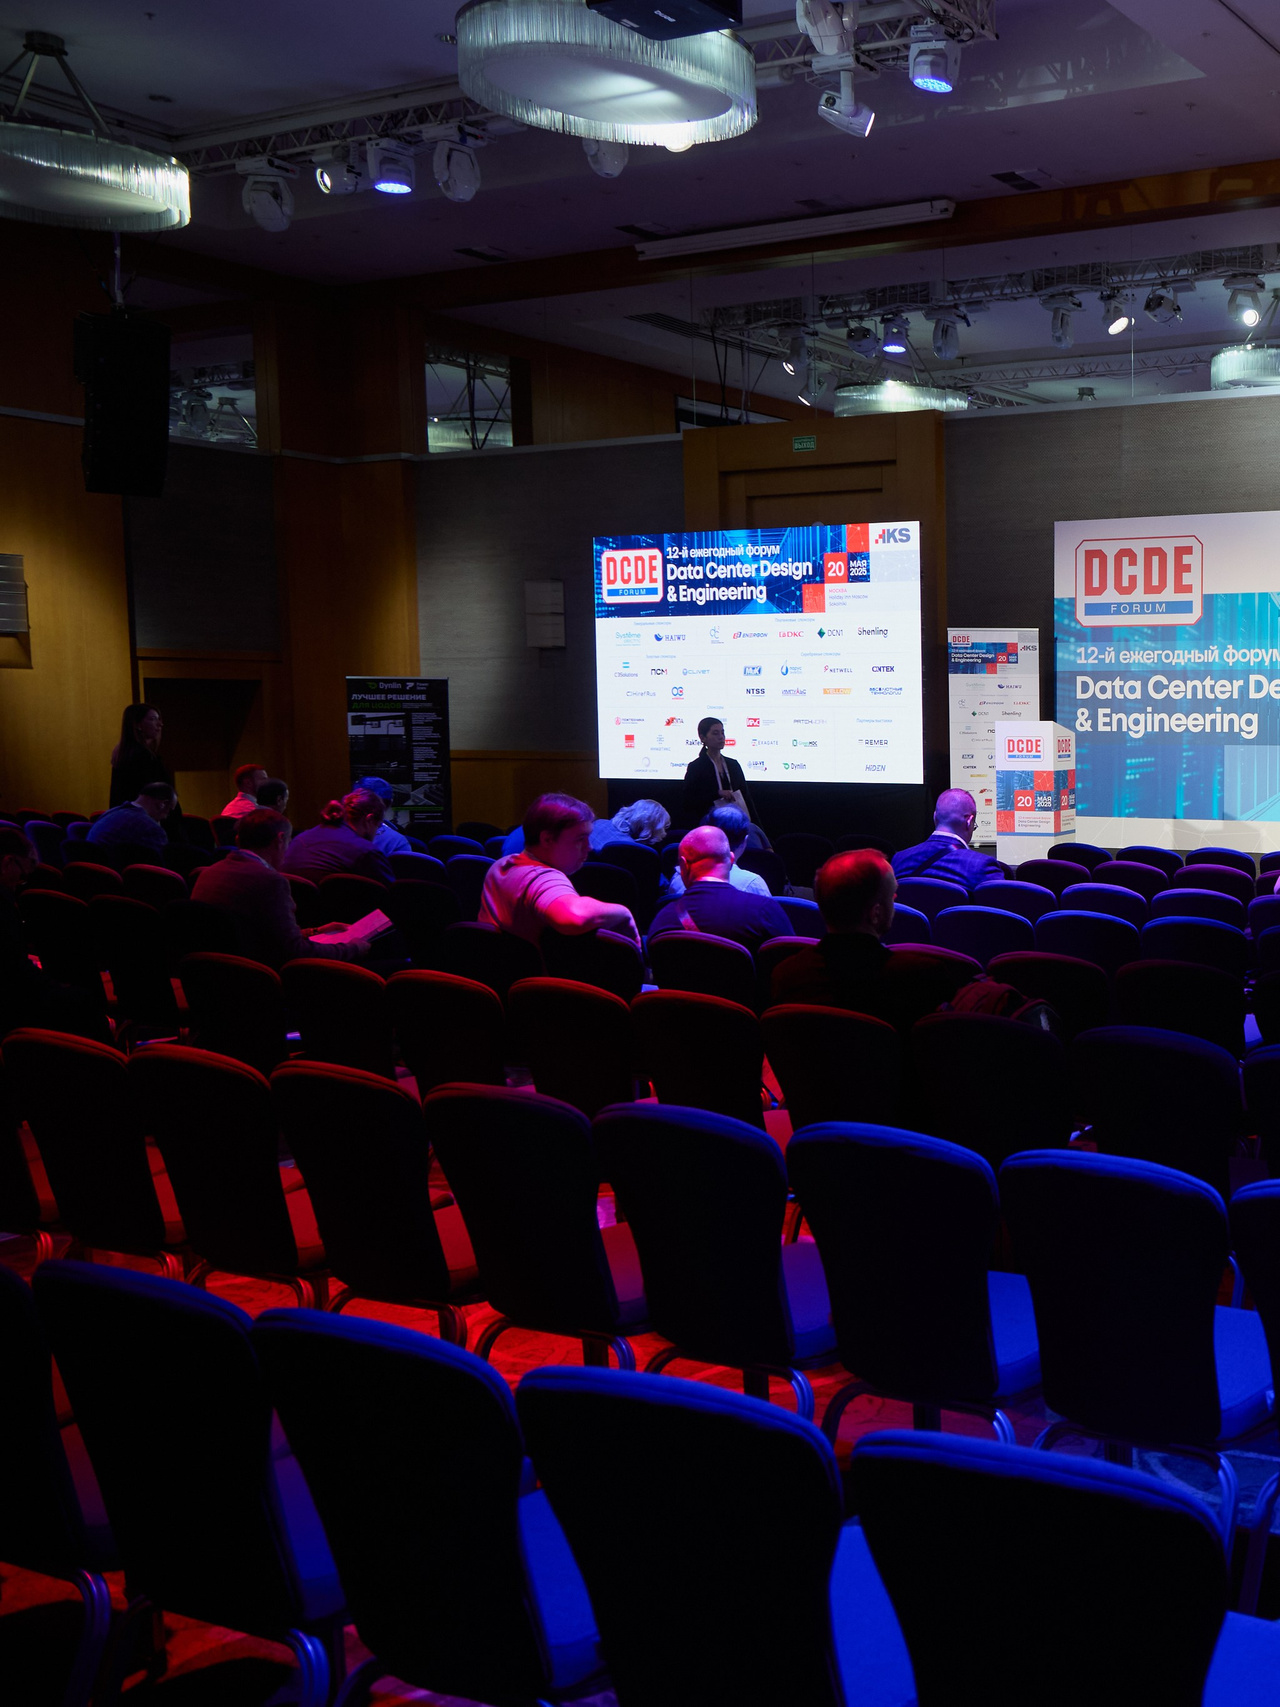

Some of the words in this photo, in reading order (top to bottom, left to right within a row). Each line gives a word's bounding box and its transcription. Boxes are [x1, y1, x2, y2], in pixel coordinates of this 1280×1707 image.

[666, 546, 688, 559] 12-й
[690, 544, 744, 558] ежегодный
[745, 543, 780, 558] форум
[606, 555, 658, 585] DCDE
[666, 563, 703, 580] Data
[706, 561, 758, 579] Center
[760, 558, 813, 580] Design
[827, 561, 845, 577] 20
[850, 560, 867, 568] МАЯ
[850, 568, 867, 576] 2025
[1084, 545, 1193, 596] DCDE
[667, 585, 678, 602] &
[679, 582, 767, 606] Engineering
[1111, 603, 1167, 614] FORUM
[857, 627, 888, 638] Shenling
[1076, 646, 1115, 664] 12-й
[1119, 645, 1219, 666] ежегодный
[1075, 675, 1142, 700] Data
[1148, 674, 1244, 700] Center
[1075, 708, 1093, 732] &
[1097, 707, 1259, 739] Engineering
[1007, 739, 1041, 753] DCDE
[1017, 796, 1032, 807] 20
